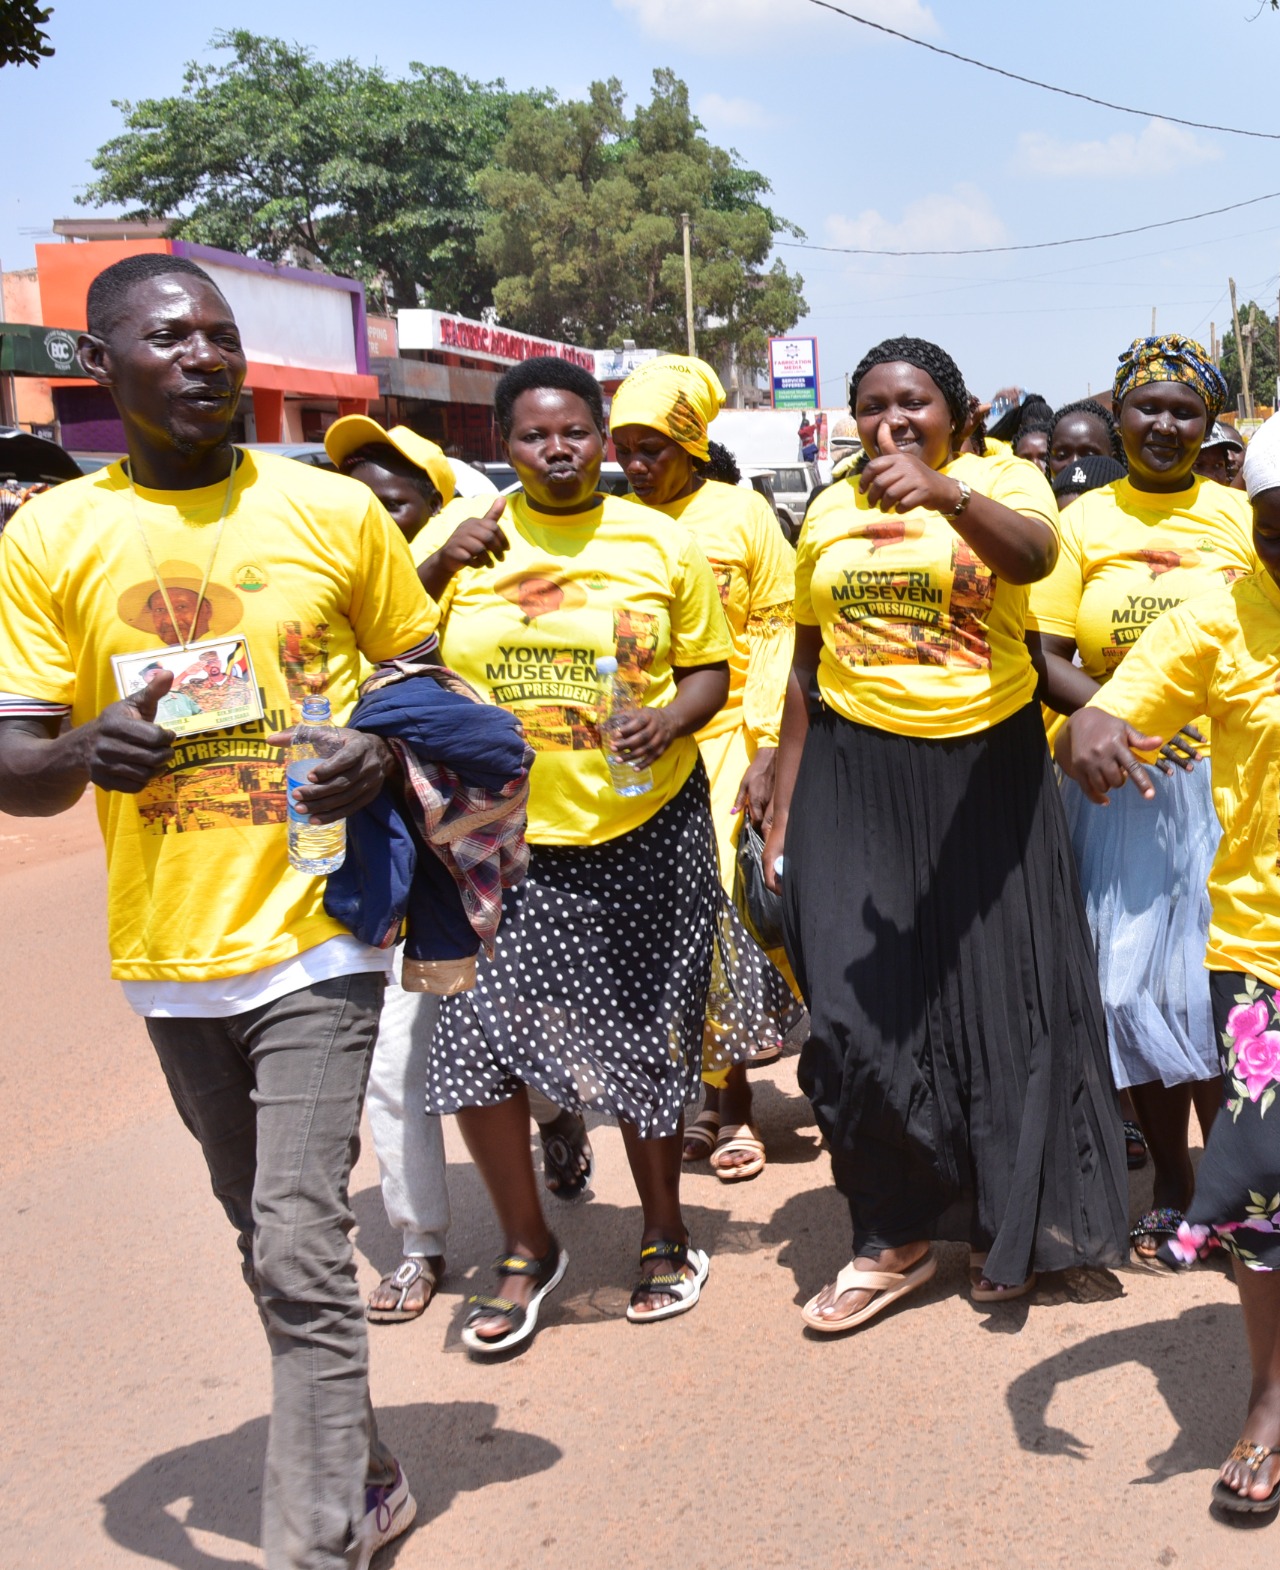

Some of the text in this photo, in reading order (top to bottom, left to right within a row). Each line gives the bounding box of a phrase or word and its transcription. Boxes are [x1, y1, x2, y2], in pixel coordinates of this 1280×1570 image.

[51, 342, 69, 359] BOC
[1072, 466, 1087, 483] LA
[843, 569, 930, 587] YOWERI
[831, 585, 943, 604] MUSEVENI
[1127, 595, 1186, 611] YOW
[846, 603, 936, 623] FOR PRESIDENT
[1118, 628, 1141, 643] FOR
[498, 646, 595, 665] YOWERI
[497, 683, 598, 704] FOR PRESIDENT
[168, 741, 281, 768] OR PRESIDENT
